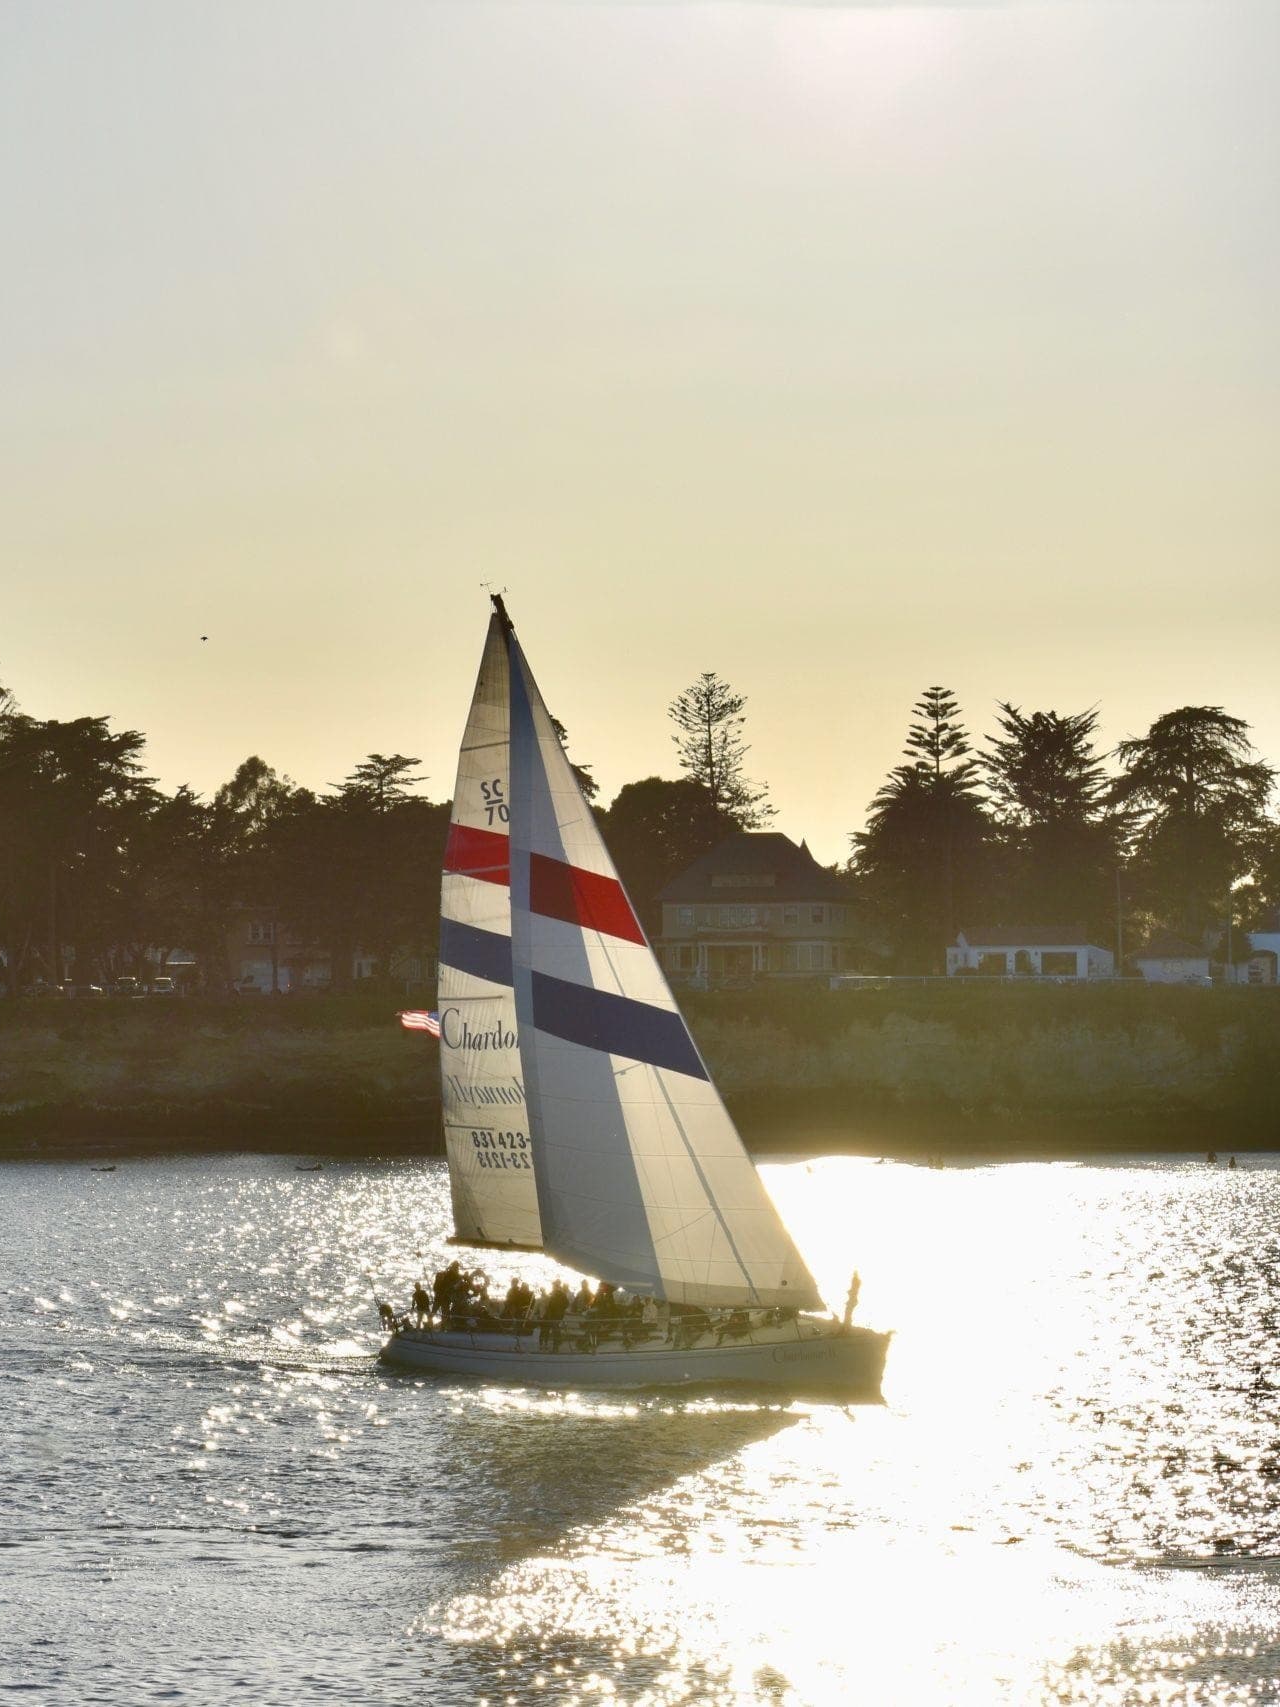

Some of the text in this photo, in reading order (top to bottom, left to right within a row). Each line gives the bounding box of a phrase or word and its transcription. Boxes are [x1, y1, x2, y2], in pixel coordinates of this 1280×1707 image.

[480, 778, 503, 800] SC
[484, 803, 510, 826] 70
[440, 1007, 520, 1051] Chardo
[472, 1130, 532, 1150] 831 423-
